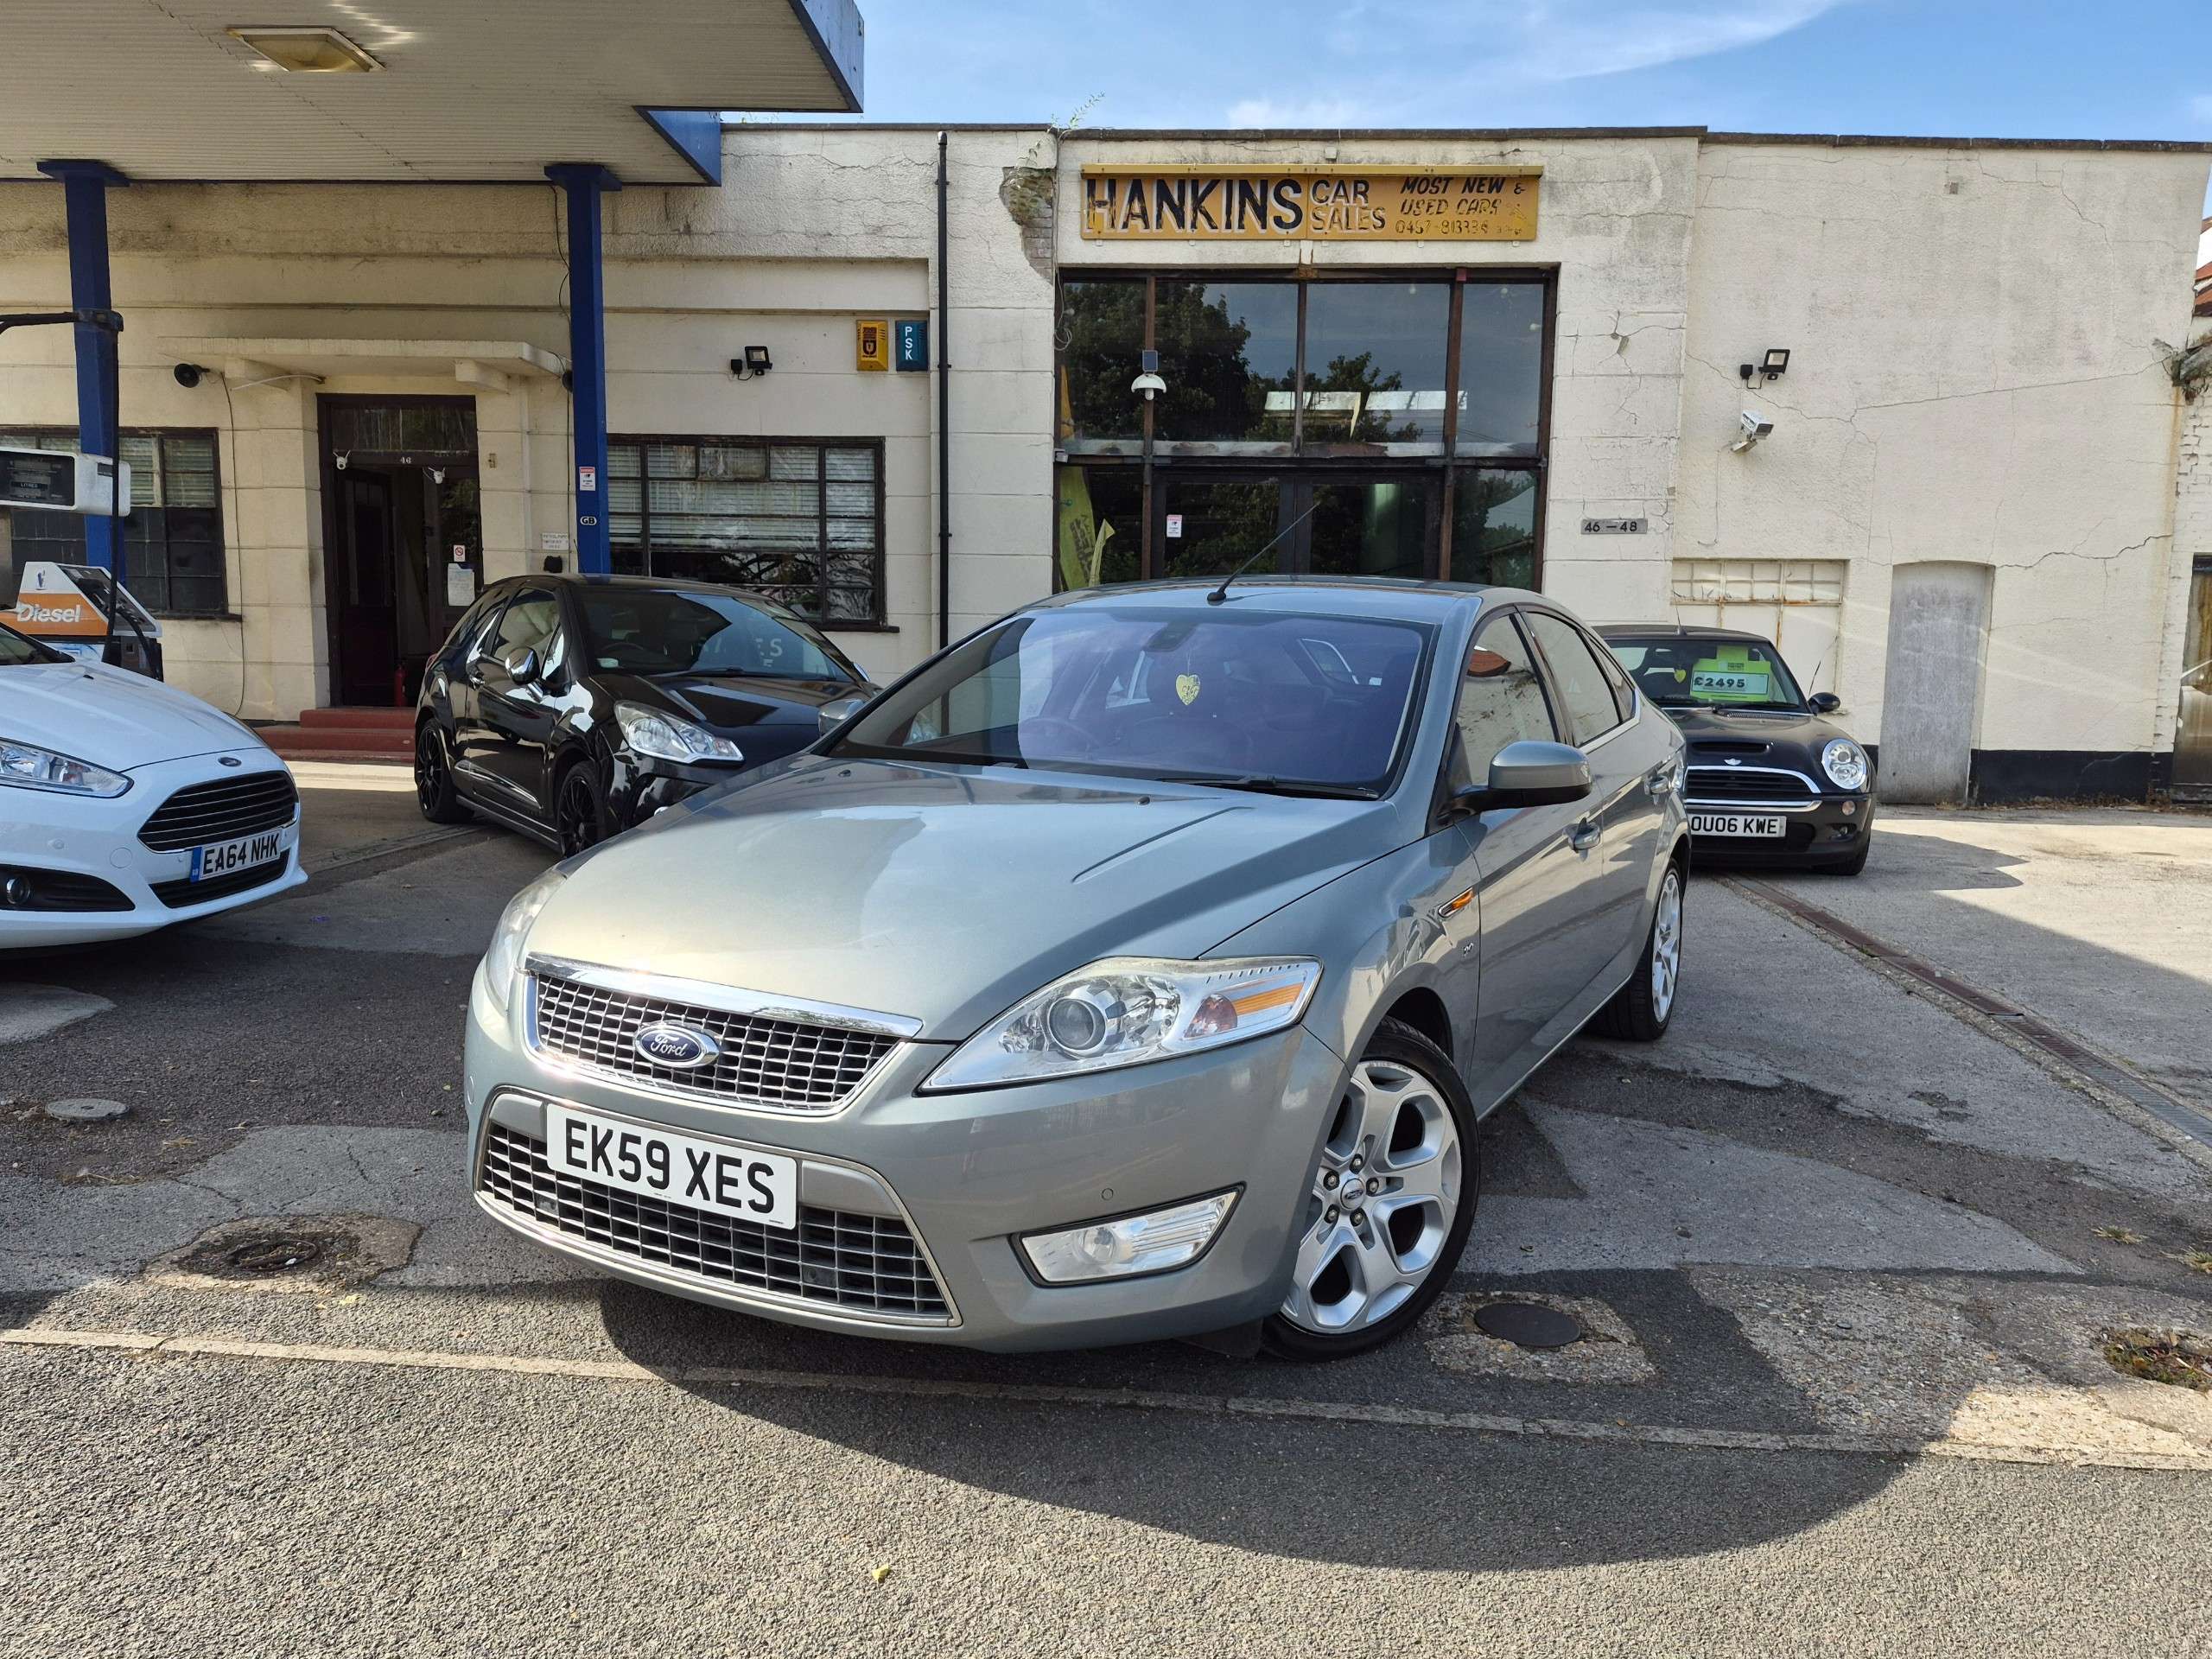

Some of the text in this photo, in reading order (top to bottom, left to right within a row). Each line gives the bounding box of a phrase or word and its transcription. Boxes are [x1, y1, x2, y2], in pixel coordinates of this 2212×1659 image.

[1311, 178, 1370, 205] CAR
[1400, 176, 1453, 194] MOST
[1461, 176, 1506, 194] NEW
[1085, 178, 1303, 232] HANKINS
[1400, 199, 1502, 216] USED CARS
[1311, 207, 1387, 231] SALES
[1585, 522, 1600, 532] 46
[1619, 522, 1637, 532] 48
[17, 604, 81, 622] Diesel
[1694, 677, 1745, 688] £2495
[1691, 816, 1778, 835] OU06 KWE
[202, 833, 280, 875] EA64 NHK
[650, 1033, 689, 1057] Ford
[565, 1117, 775, 1214] EK59 XES
